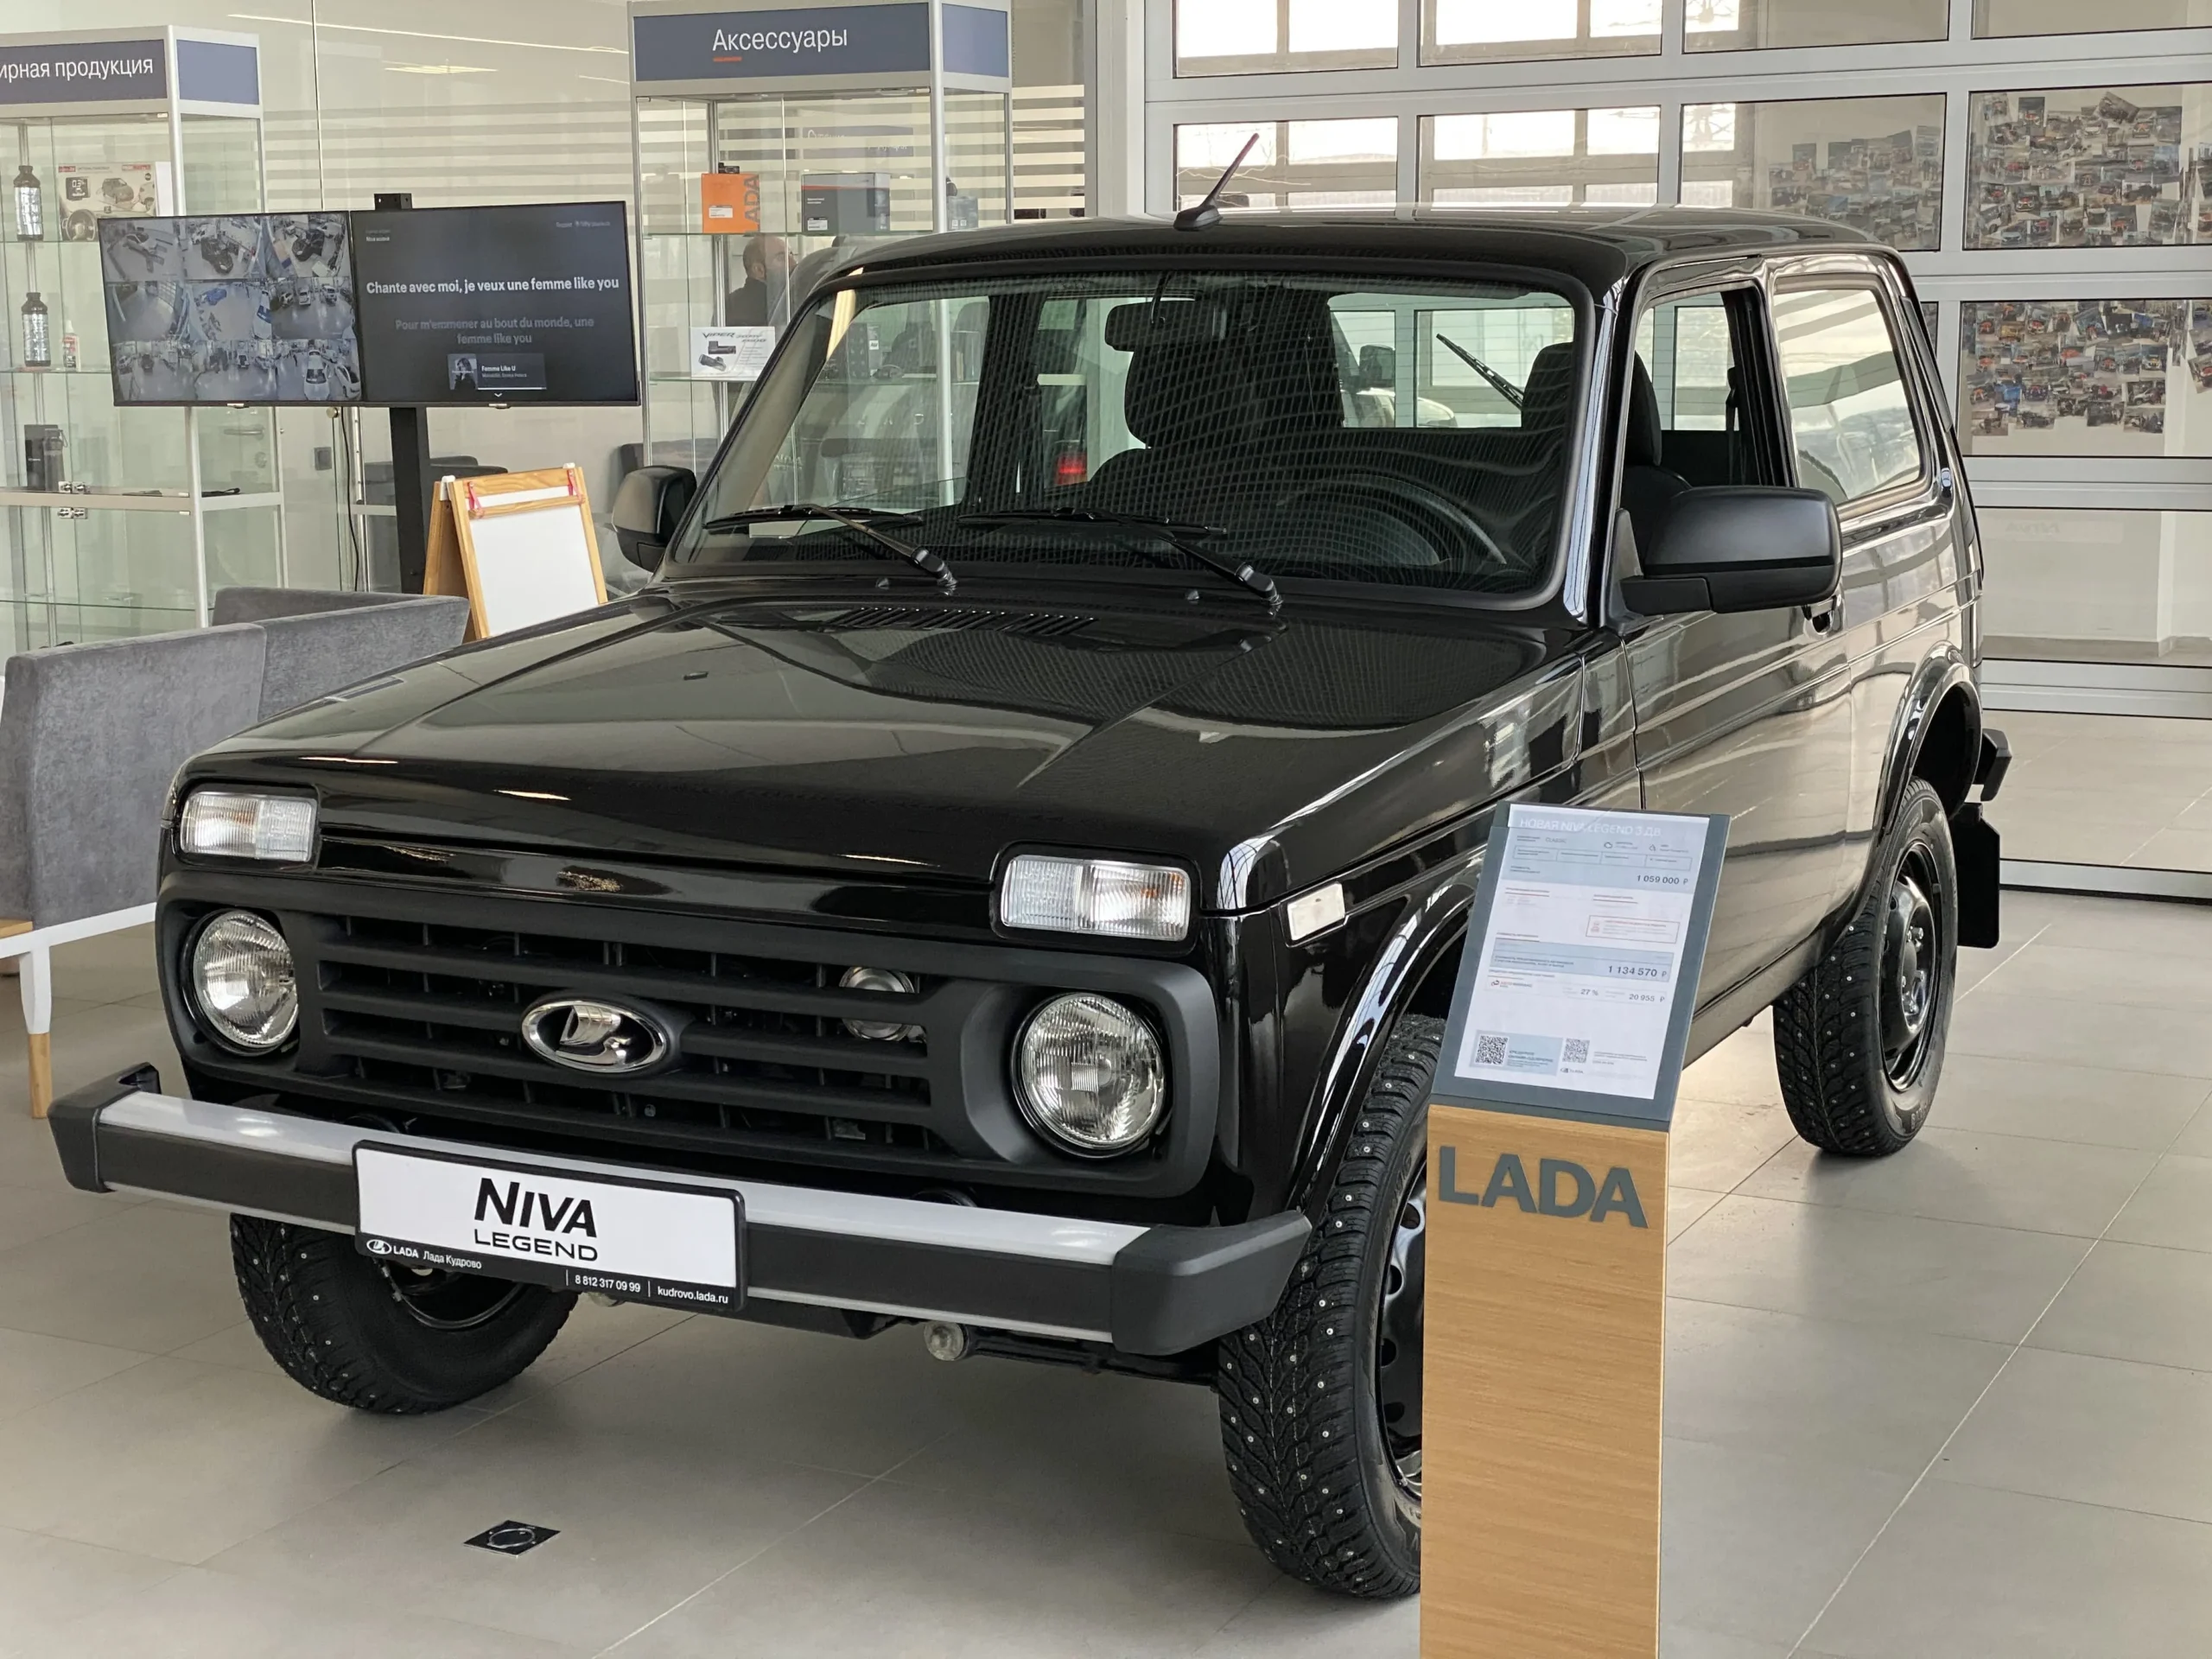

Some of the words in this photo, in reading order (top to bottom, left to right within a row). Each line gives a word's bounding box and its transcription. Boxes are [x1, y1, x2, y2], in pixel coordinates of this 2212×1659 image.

[712, 29, 847, 54] Аксессуары
[55, 59, 153, 81] продукция
[366, 281, 408, 294] Chante
[409, 283, 435, 293] avec
[438, 279, 462, 294] moi,
[464, 278, 475, 295] je
[477, 281, 505, 292] veux
[507, 280, 530, 291] une
[531, 277, 571, 290] femme
[574, 276, 595, 289] like
[597, 277, 620, 290] you
[395, 320, 418, 330] Pour
[480, 320, 493, 329] au
[494, 318, 518, 329] bout
[519, 317, 533, 328] du
[535, 316, 573, 329] monde,
[575, 317, 594, 327] une
[457, 334, 493, 345] femme
[493, 334, 512, 344] like
[513, 334, 532, 346] you
[1662, 876, 1680, 885] 000
[1618, 966, 1635, 976] 134
[1638, 968, 1657, 977] 570
[1439, 1146, 1649, 1229] LADA
[474, 1178, 597, 1238] NIVA
[474, 1229, 598, 1262] LEGEND
[393, 1245, 419, 1258] LADA
[423, 1251, 445, 1263] Лада
[446, 1255, 482, 1269] Кудрово
[575, 1274, 581, 1285] 8
[583, 1276, 598, 1287] 812
[599, 1278, 614, 1288] 317
[616, 1280, 628, 1291] 09
[629, 1281, 641, 1293] 99
[658, 1286, 728, 1304] kudrovo.lada.ru
